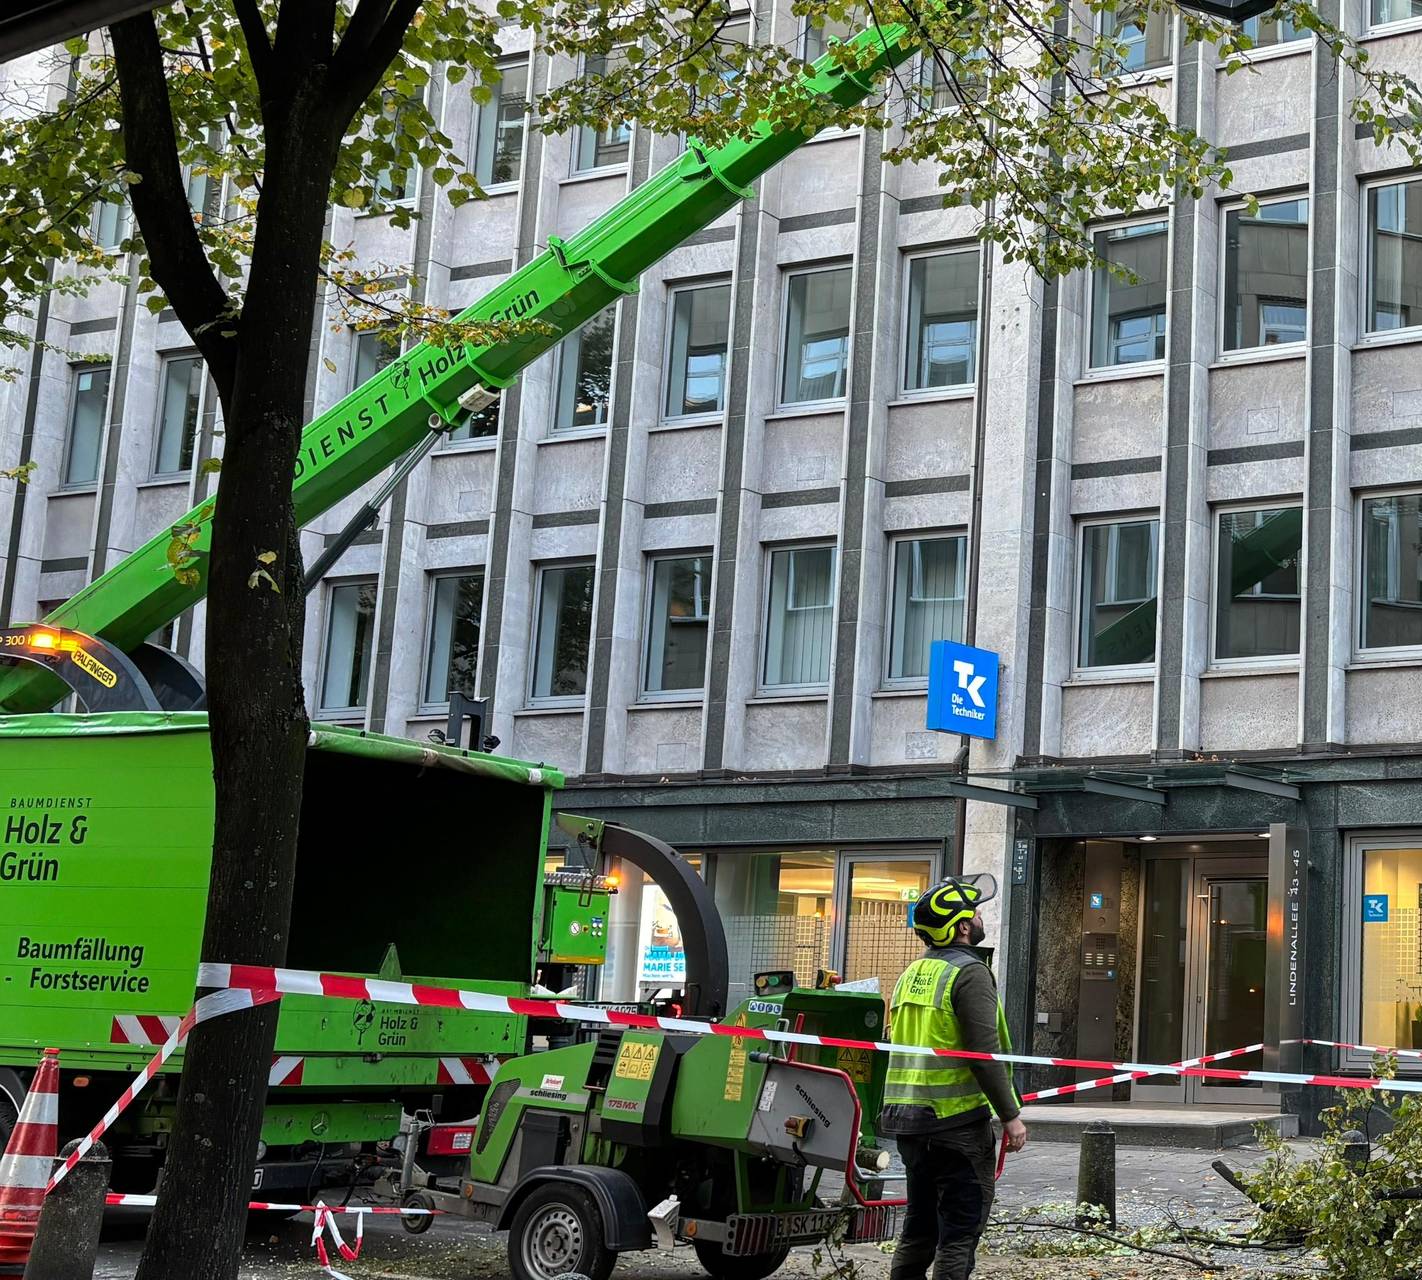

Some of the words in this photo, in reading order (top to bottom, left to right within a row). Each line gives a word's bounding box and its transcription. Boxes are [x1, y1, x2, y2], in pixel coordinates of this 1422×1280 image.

[5, 635, 25, 645] 300
[73, 650, 114, 685] PALFINGER
[953, 660, 987, 708] TK
[951, 692, 963, 704] Die
[952, 704, 985, 720] Techniker
[10, 797, 93, 808] BAUMDIENST
[4, 813, 63, 844] Holz
[69, 815, 88, 845] &
[0, 852, 59, 881] Grün
[1292, 849, 1300, 867] 45
[1368, 899, 1384, 913] TK
[17, 936, 144, 968] Baumfällung
[1289, 902, 1298, 1006] LINDENALLEE
[643, 962, 671, 971] MARIE
[30, 967, 149, 993] Forstservice
[380, 1016, 407, 1030] Holz
[410, 1016, 418, 1030] &
[378, 1032, 406, 1046] Grün
[530, 1089, 567, 1101] schliesing
[795, 1084, 831, 1128] schliesing
[792, 1215, 810, 1235] SK
